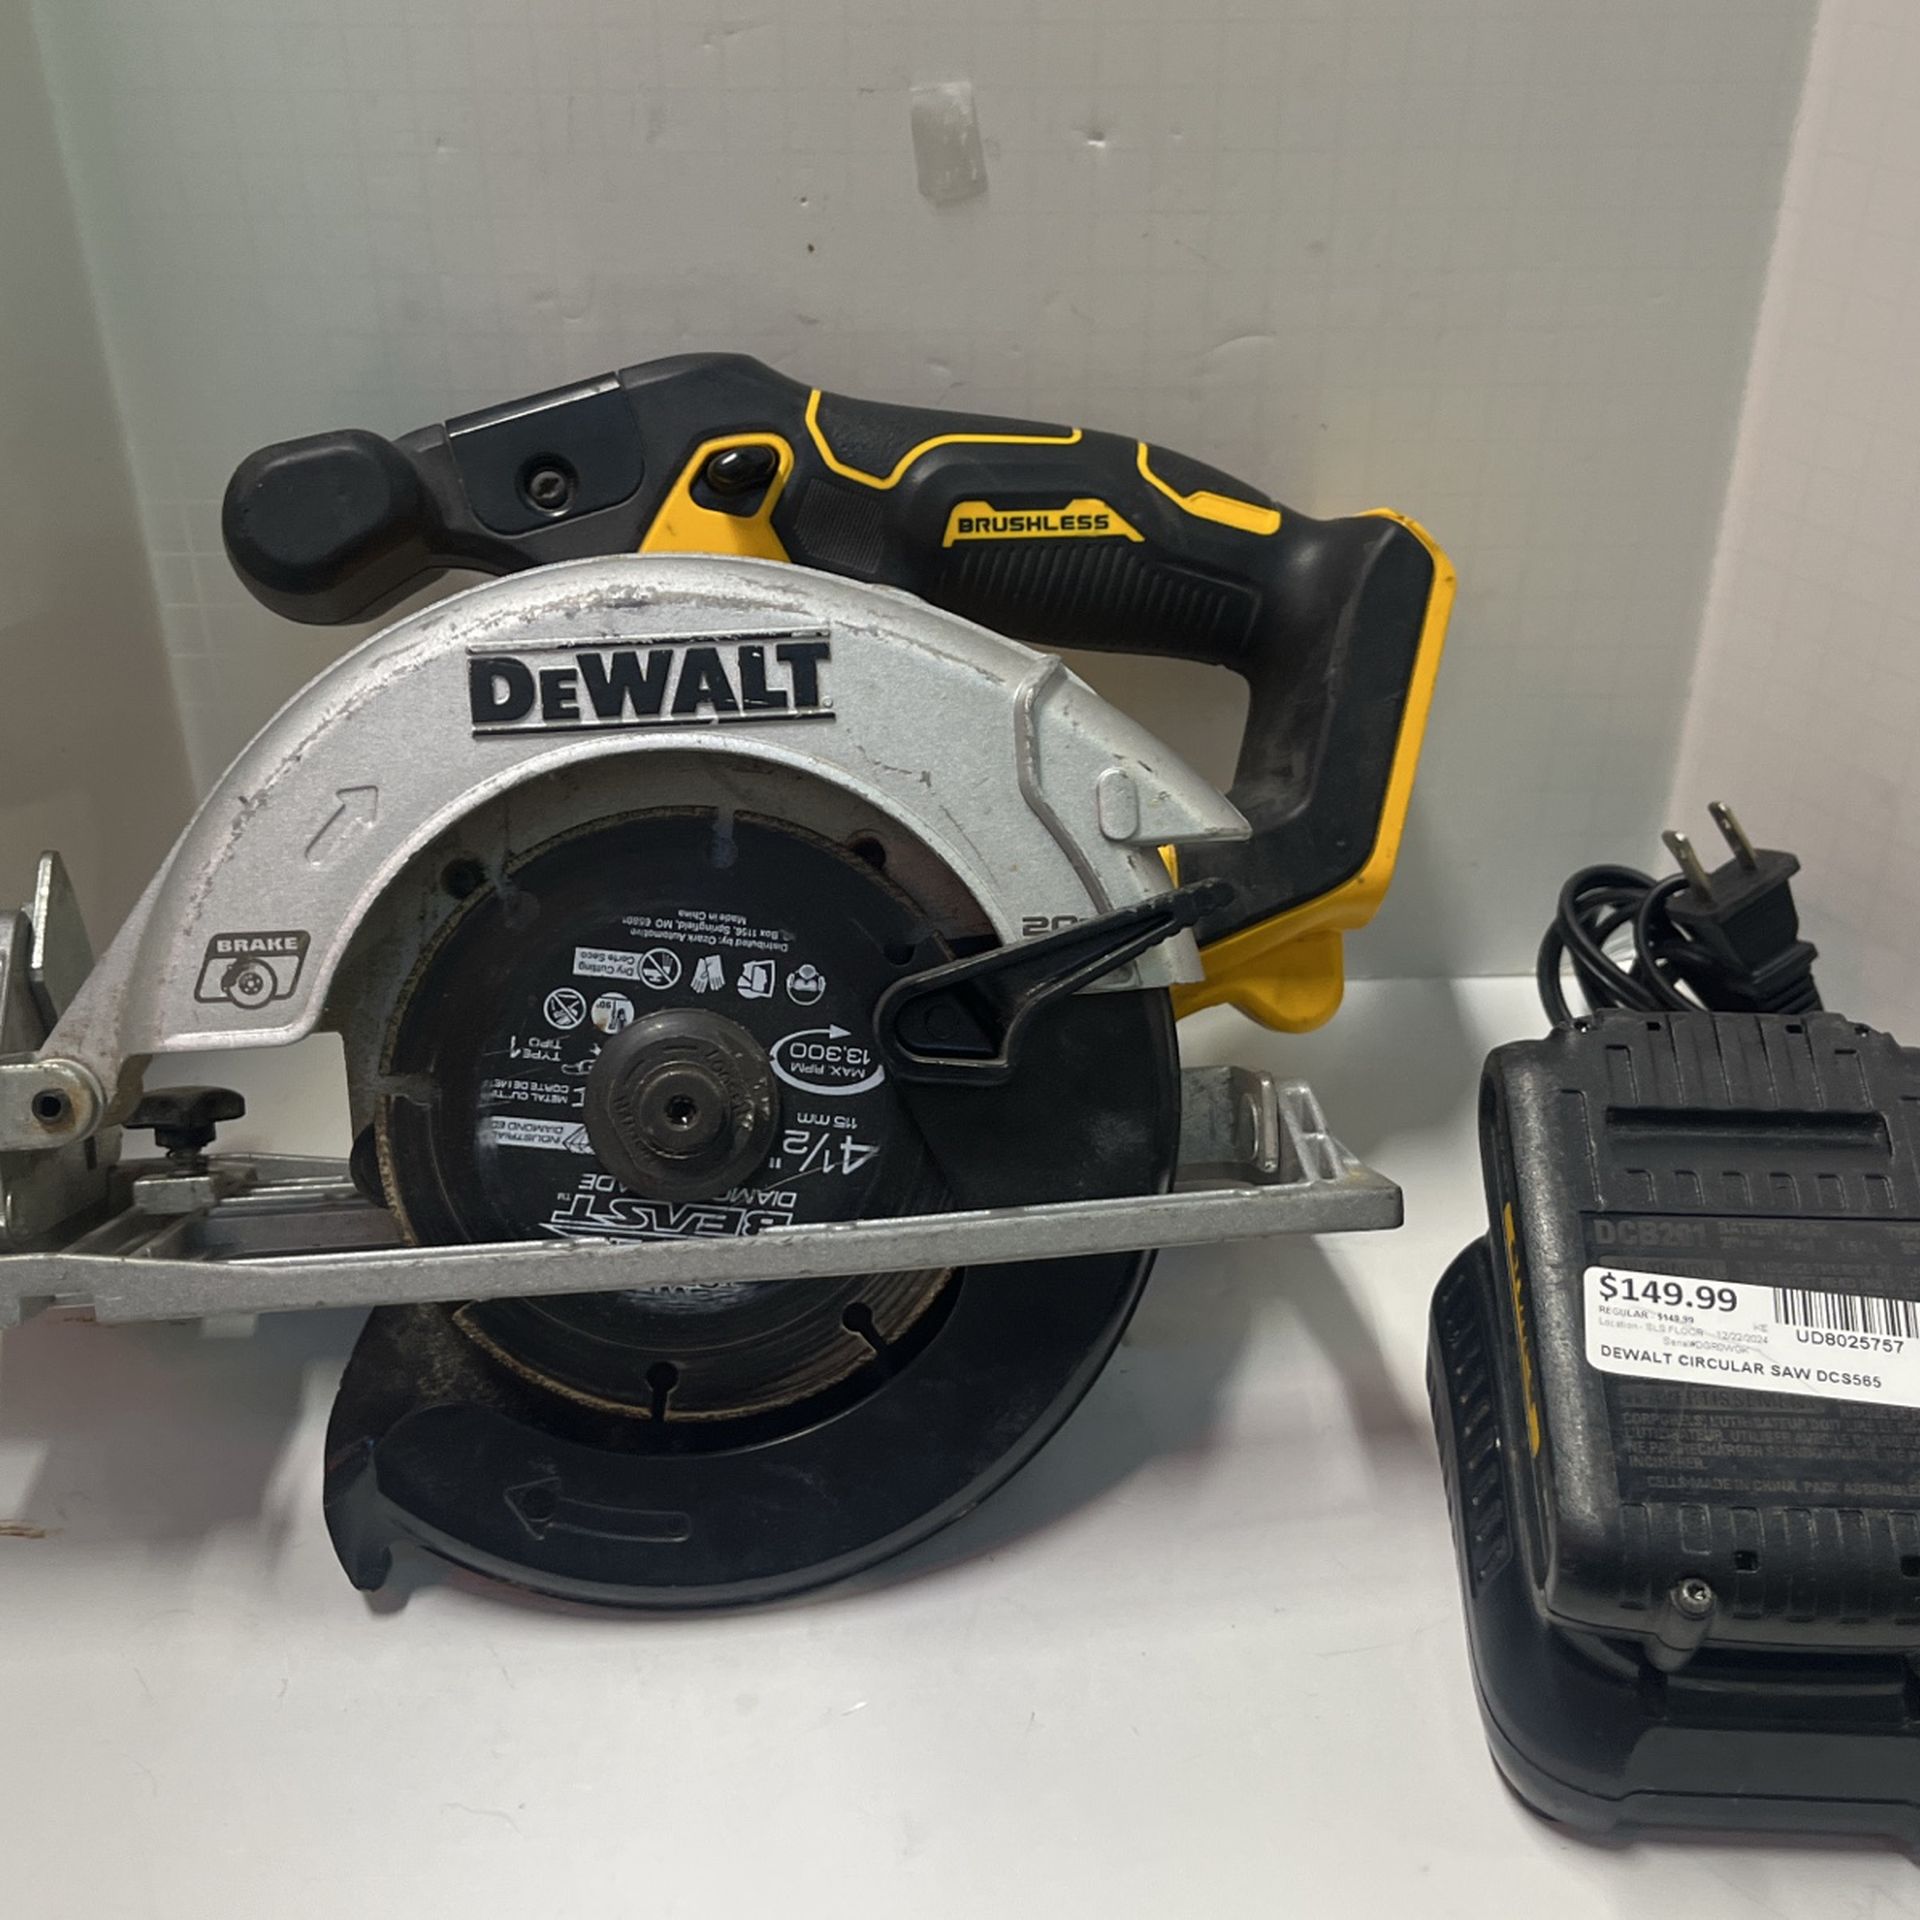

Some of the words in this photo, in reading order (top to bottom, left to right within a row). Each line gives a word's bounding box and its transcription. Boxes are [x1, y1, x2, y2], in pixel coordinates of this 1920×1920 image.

[957, 514, 1109, 534] BRUSHLESS
[216, 936, 298, 953] BRAKE
[735, 937, 789, 953] Distributed
[616, 965, 635, 977] Dry
[528, 1037, 562, 1050] TIPO
[523, 1048, 562, 1062] TYPE
[790, 1062, 825, 1075] RPM
[530, 1092, 569, 1104] METAL
[797, 1111, 831, 1126] mm
[551, 1193, 794, 1237] BEAST
[1599, 1272, 1738, 1313] $149.99
[1599, 1304, 1648, 1319] REGULAR
[1668, 1324, 1704, 1338] FLOOR
[1795, 1328, 1905, 1354] UD8025757
[1600, 1344, 1673, 1365] DEWALT
[1677, 1354, 1765, 1375] CIRCULAR
[1770, 1363, 1811, 1380] SAW
[1816, 1369, 1882, 1389] DCS565
